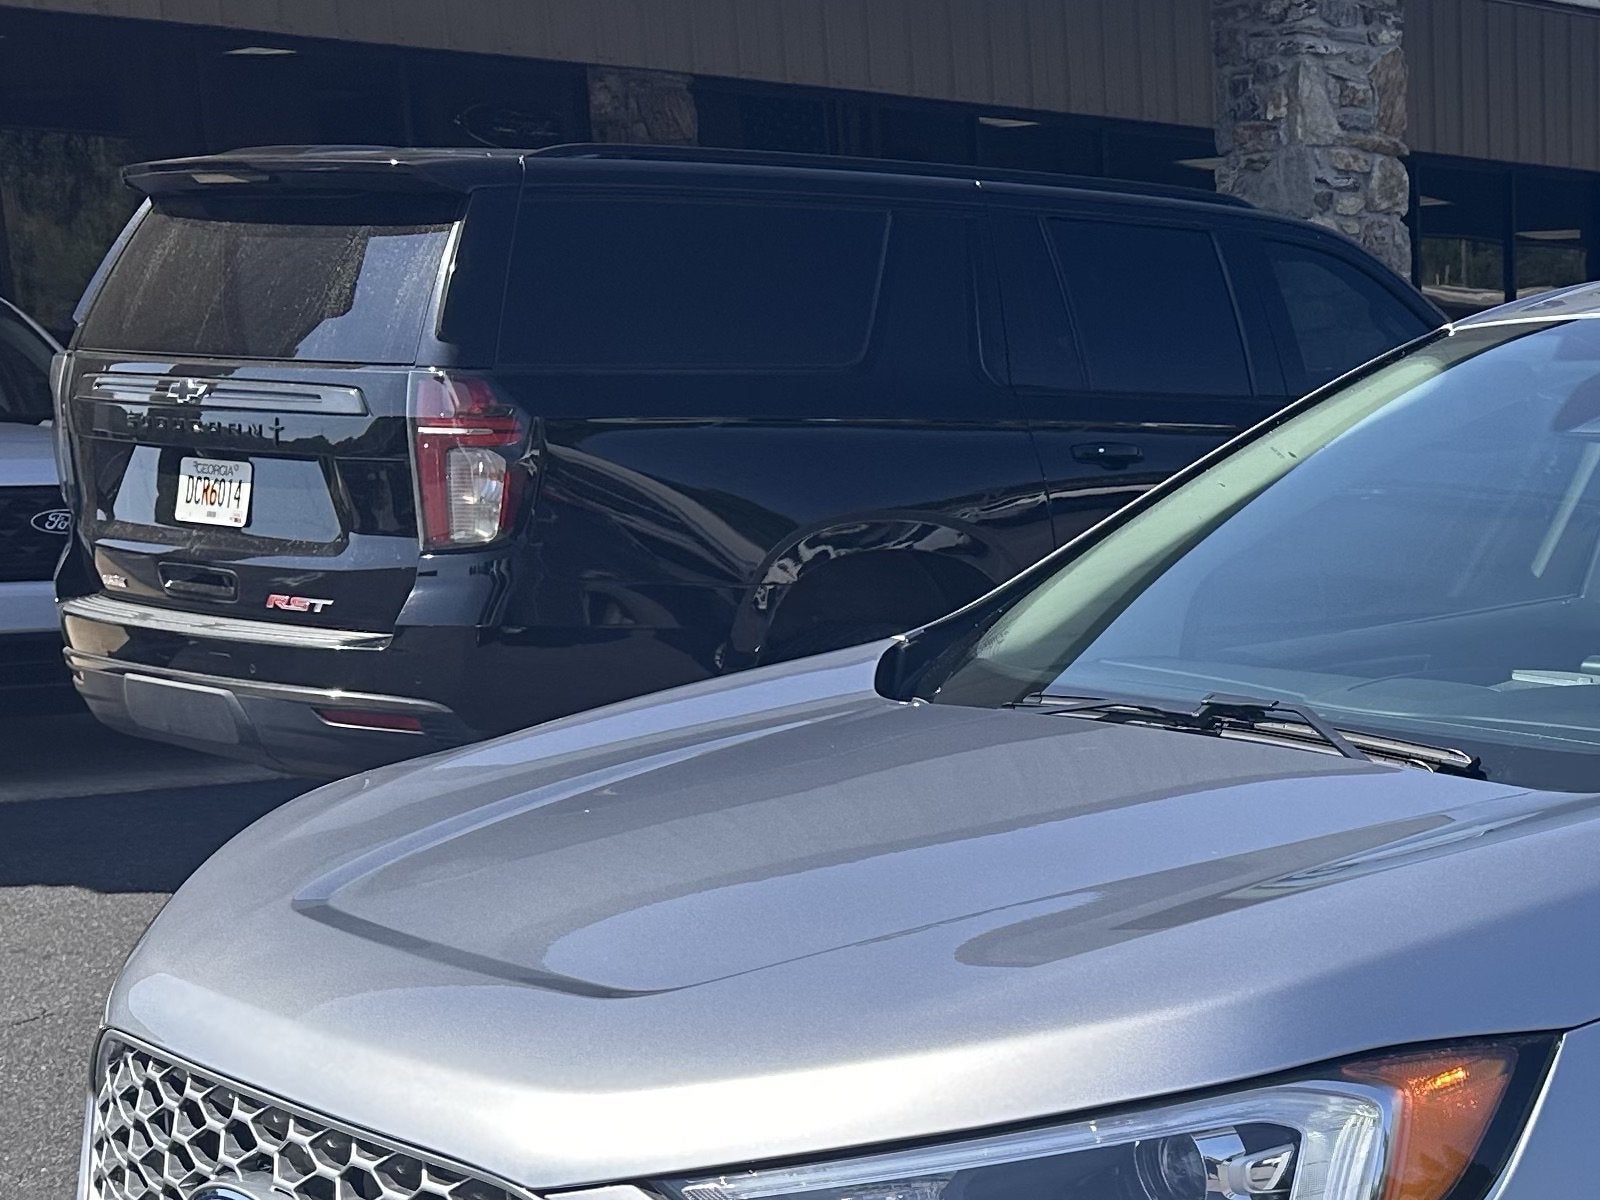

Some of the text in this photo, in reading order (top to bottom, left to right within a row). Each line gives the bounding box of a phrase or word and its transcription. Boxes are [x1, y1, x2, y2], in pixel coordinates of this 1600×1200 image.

[195, 463, 234, 476] GEORGIA
[186, 475, 242, 509] DCR6014
[45, 512, 71, 530] Fo
[265, 593, 335, 613] RST
